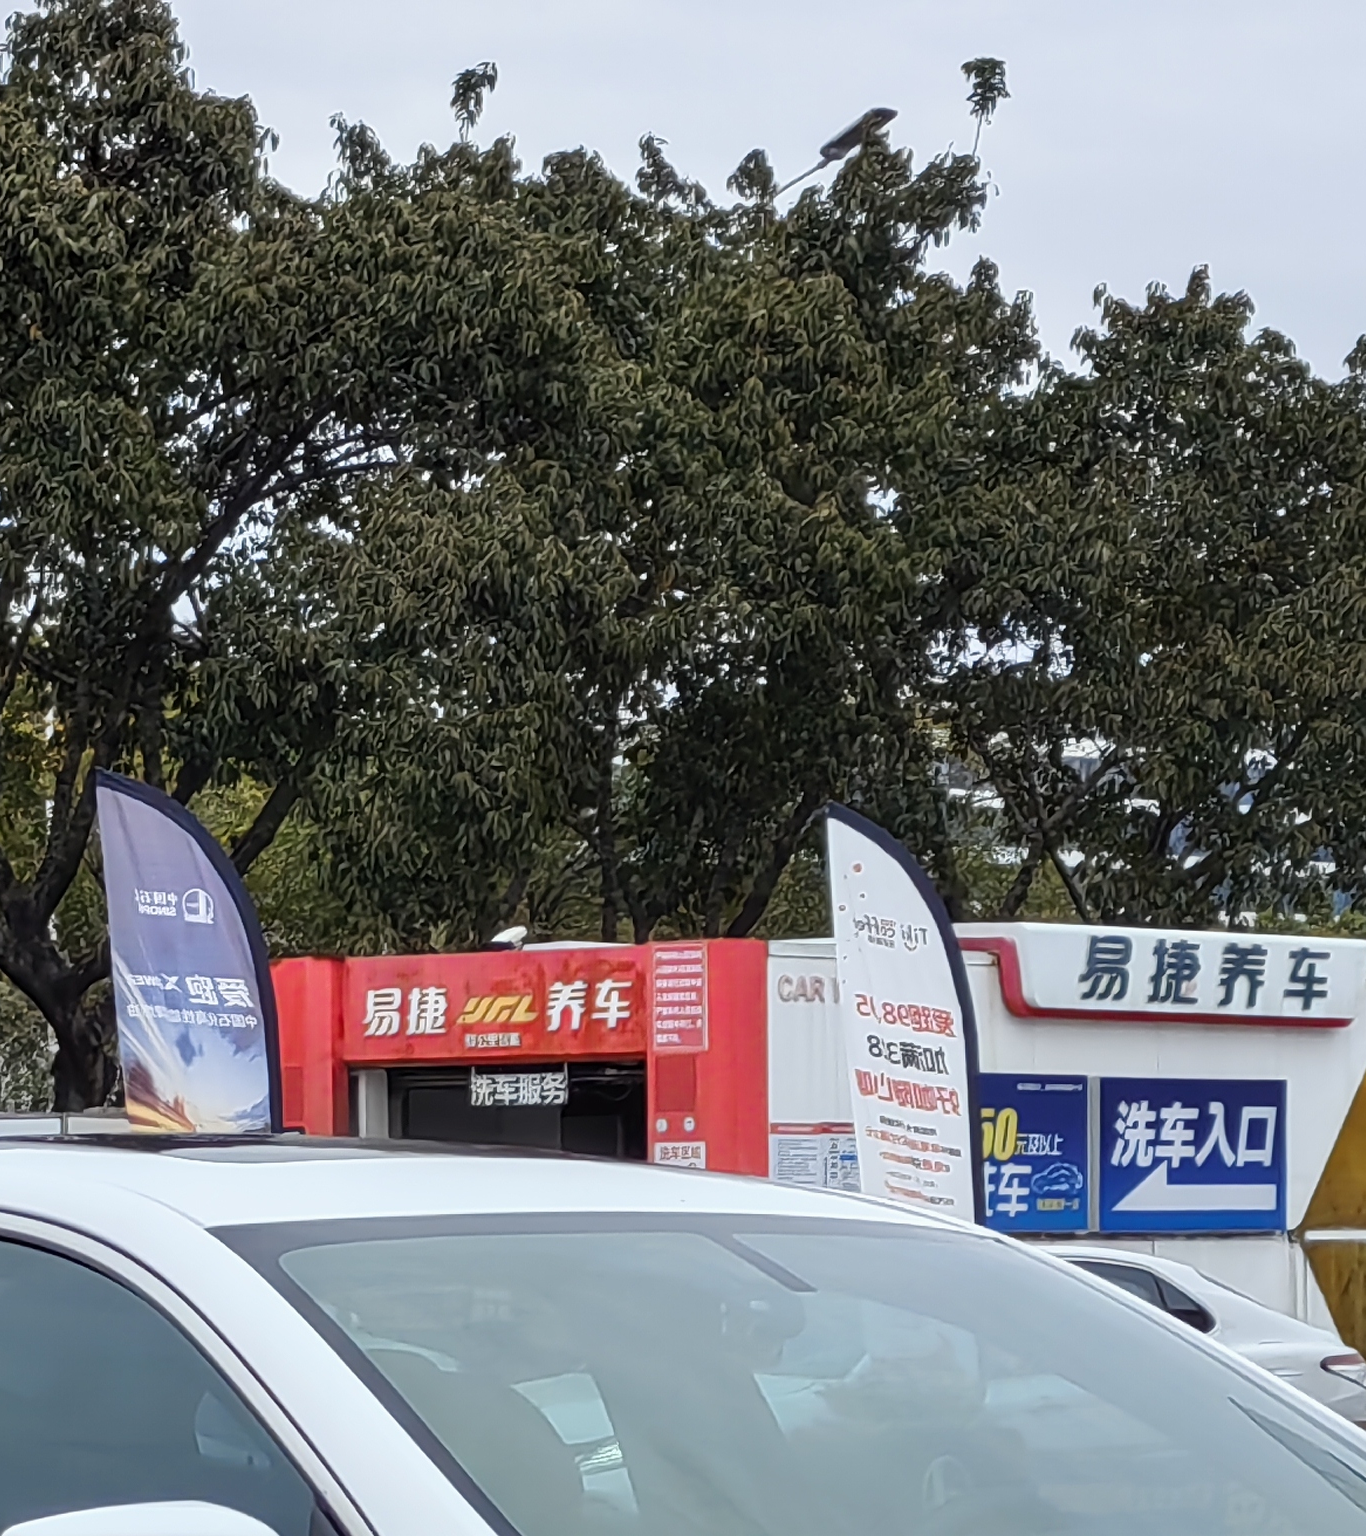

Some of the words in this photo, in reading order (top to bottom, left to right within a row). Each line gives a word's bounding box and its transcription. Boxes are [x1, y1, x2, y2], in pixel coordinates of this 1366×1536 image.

[777, 974, 826, 1004] CAR
[1078, 935, 1331, 1011] 易捷养车
[362, 986, 448, 1037] 易捷
[546, 978, 633, 1032] 养车
[470, 1071, 567, 1107] 洗车服务
[1110, 1100, 1278, 1169] 洗车入口
